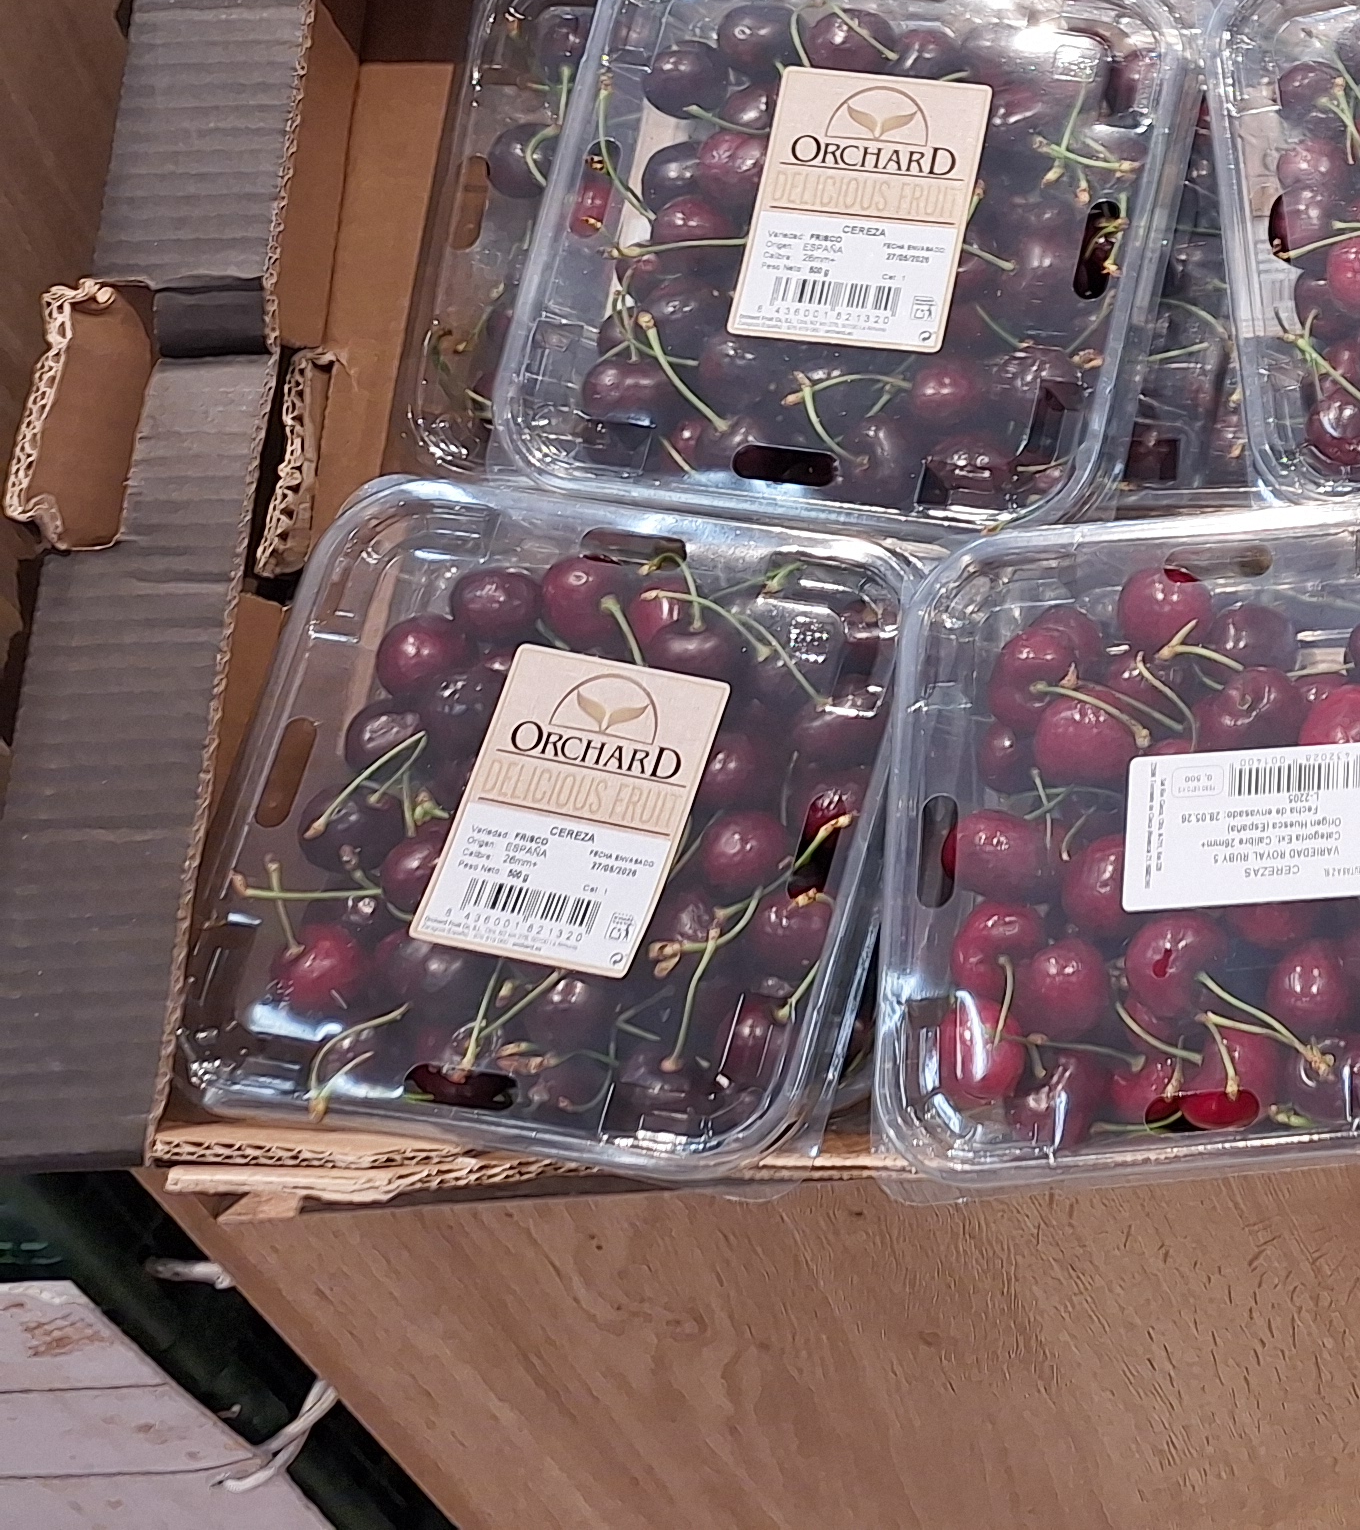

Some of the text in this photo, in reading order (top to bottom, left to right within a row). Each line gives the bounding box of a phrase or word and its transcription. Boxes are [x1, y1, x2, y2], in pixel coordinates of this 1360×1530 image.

[788, 133, 959, 177] ORCHARD
[841, 224, 887, 237] CEREZA
[506, 718, 686, 781] ORCHARD
[480, 756, 685, 829] DELICIOUS FRUIT
[1275, 806, 1286, 816] de
[1289, 804, 1317, 815] Fecha
[1226, 814, 1341, 833] Origen Huesca (España)
[548, 825, 597, 843] CEREZA
[1238, 835, 1271, 846] Calibre
[504, 840, 549, 857] ESPAÑA
[1221, 845, 1339, 862] VARIEDAD ROYAL RUBY
[1243, 864, 1299, 877] CEREZAS
